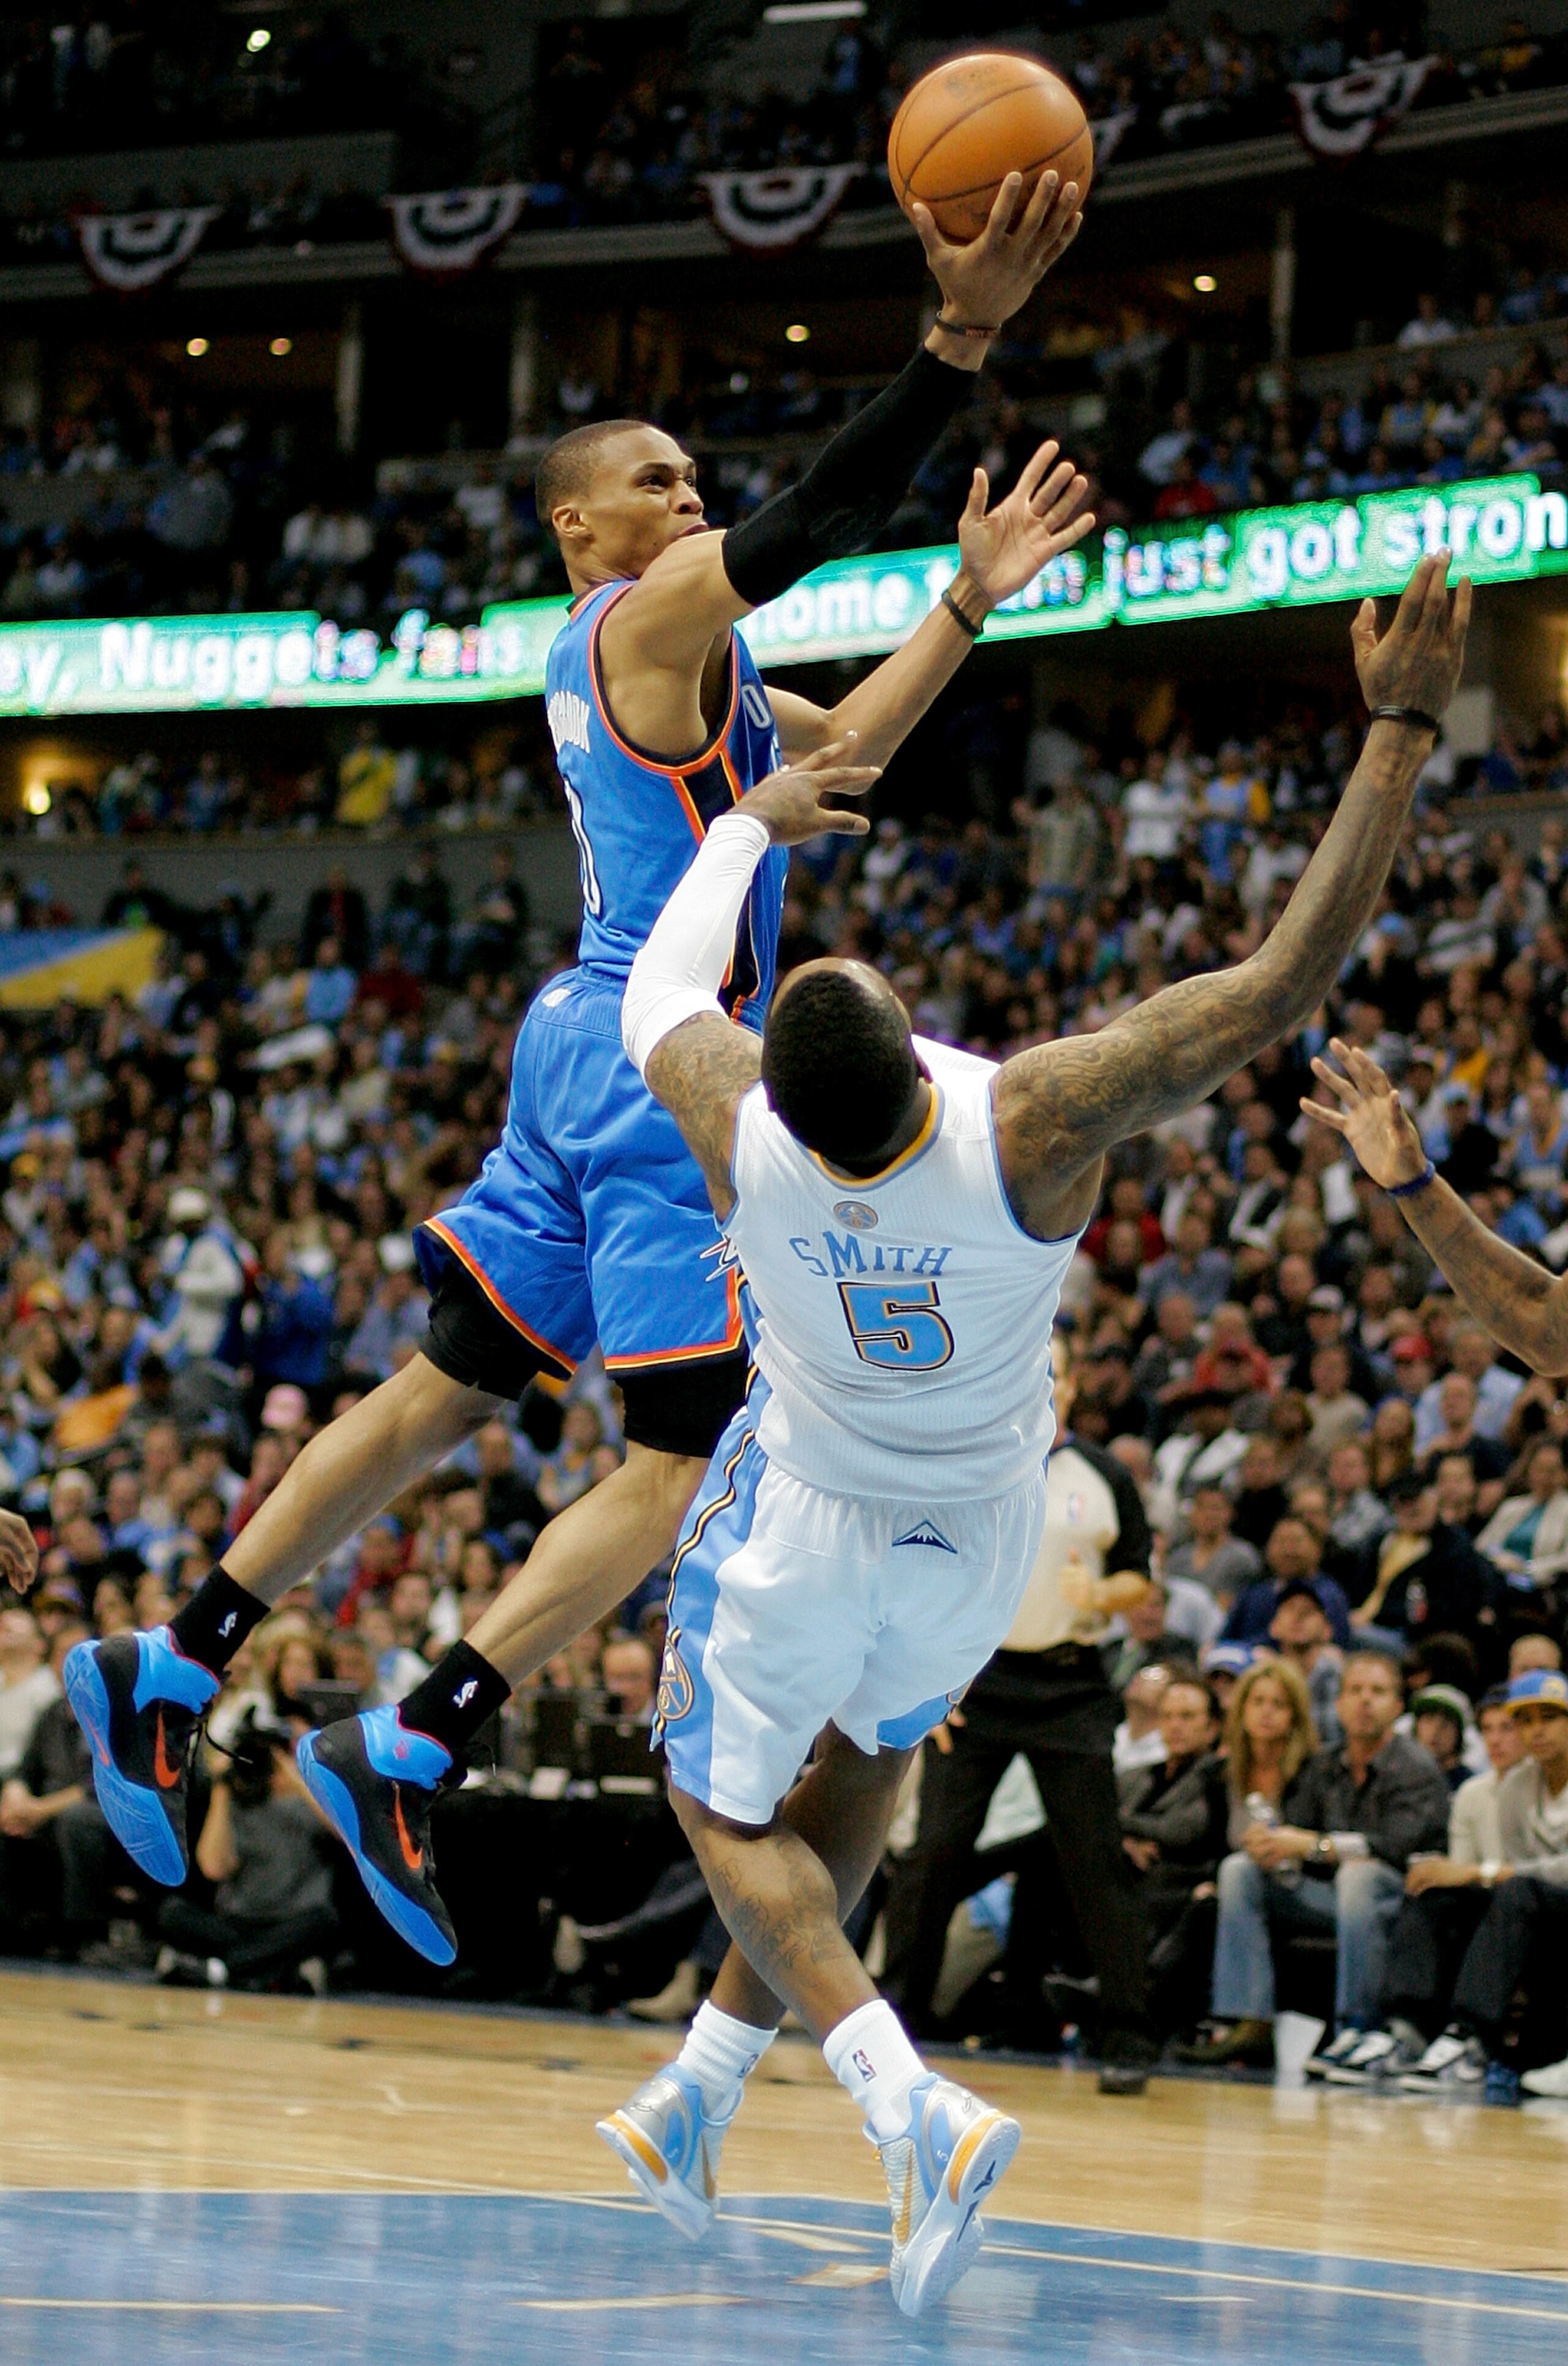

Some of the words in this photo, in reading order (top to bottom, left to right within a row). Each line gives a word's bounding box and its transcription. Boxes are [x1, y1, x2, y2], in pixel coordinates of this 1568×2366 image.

[100, 619, 379, 700] Nuggets
[1103, 524, 1229, 614] just
[1247, 505, 1361, 600] got
[790, 1230, 952, 1278] SMITH
[836, 1281, 954, 1371] 5
